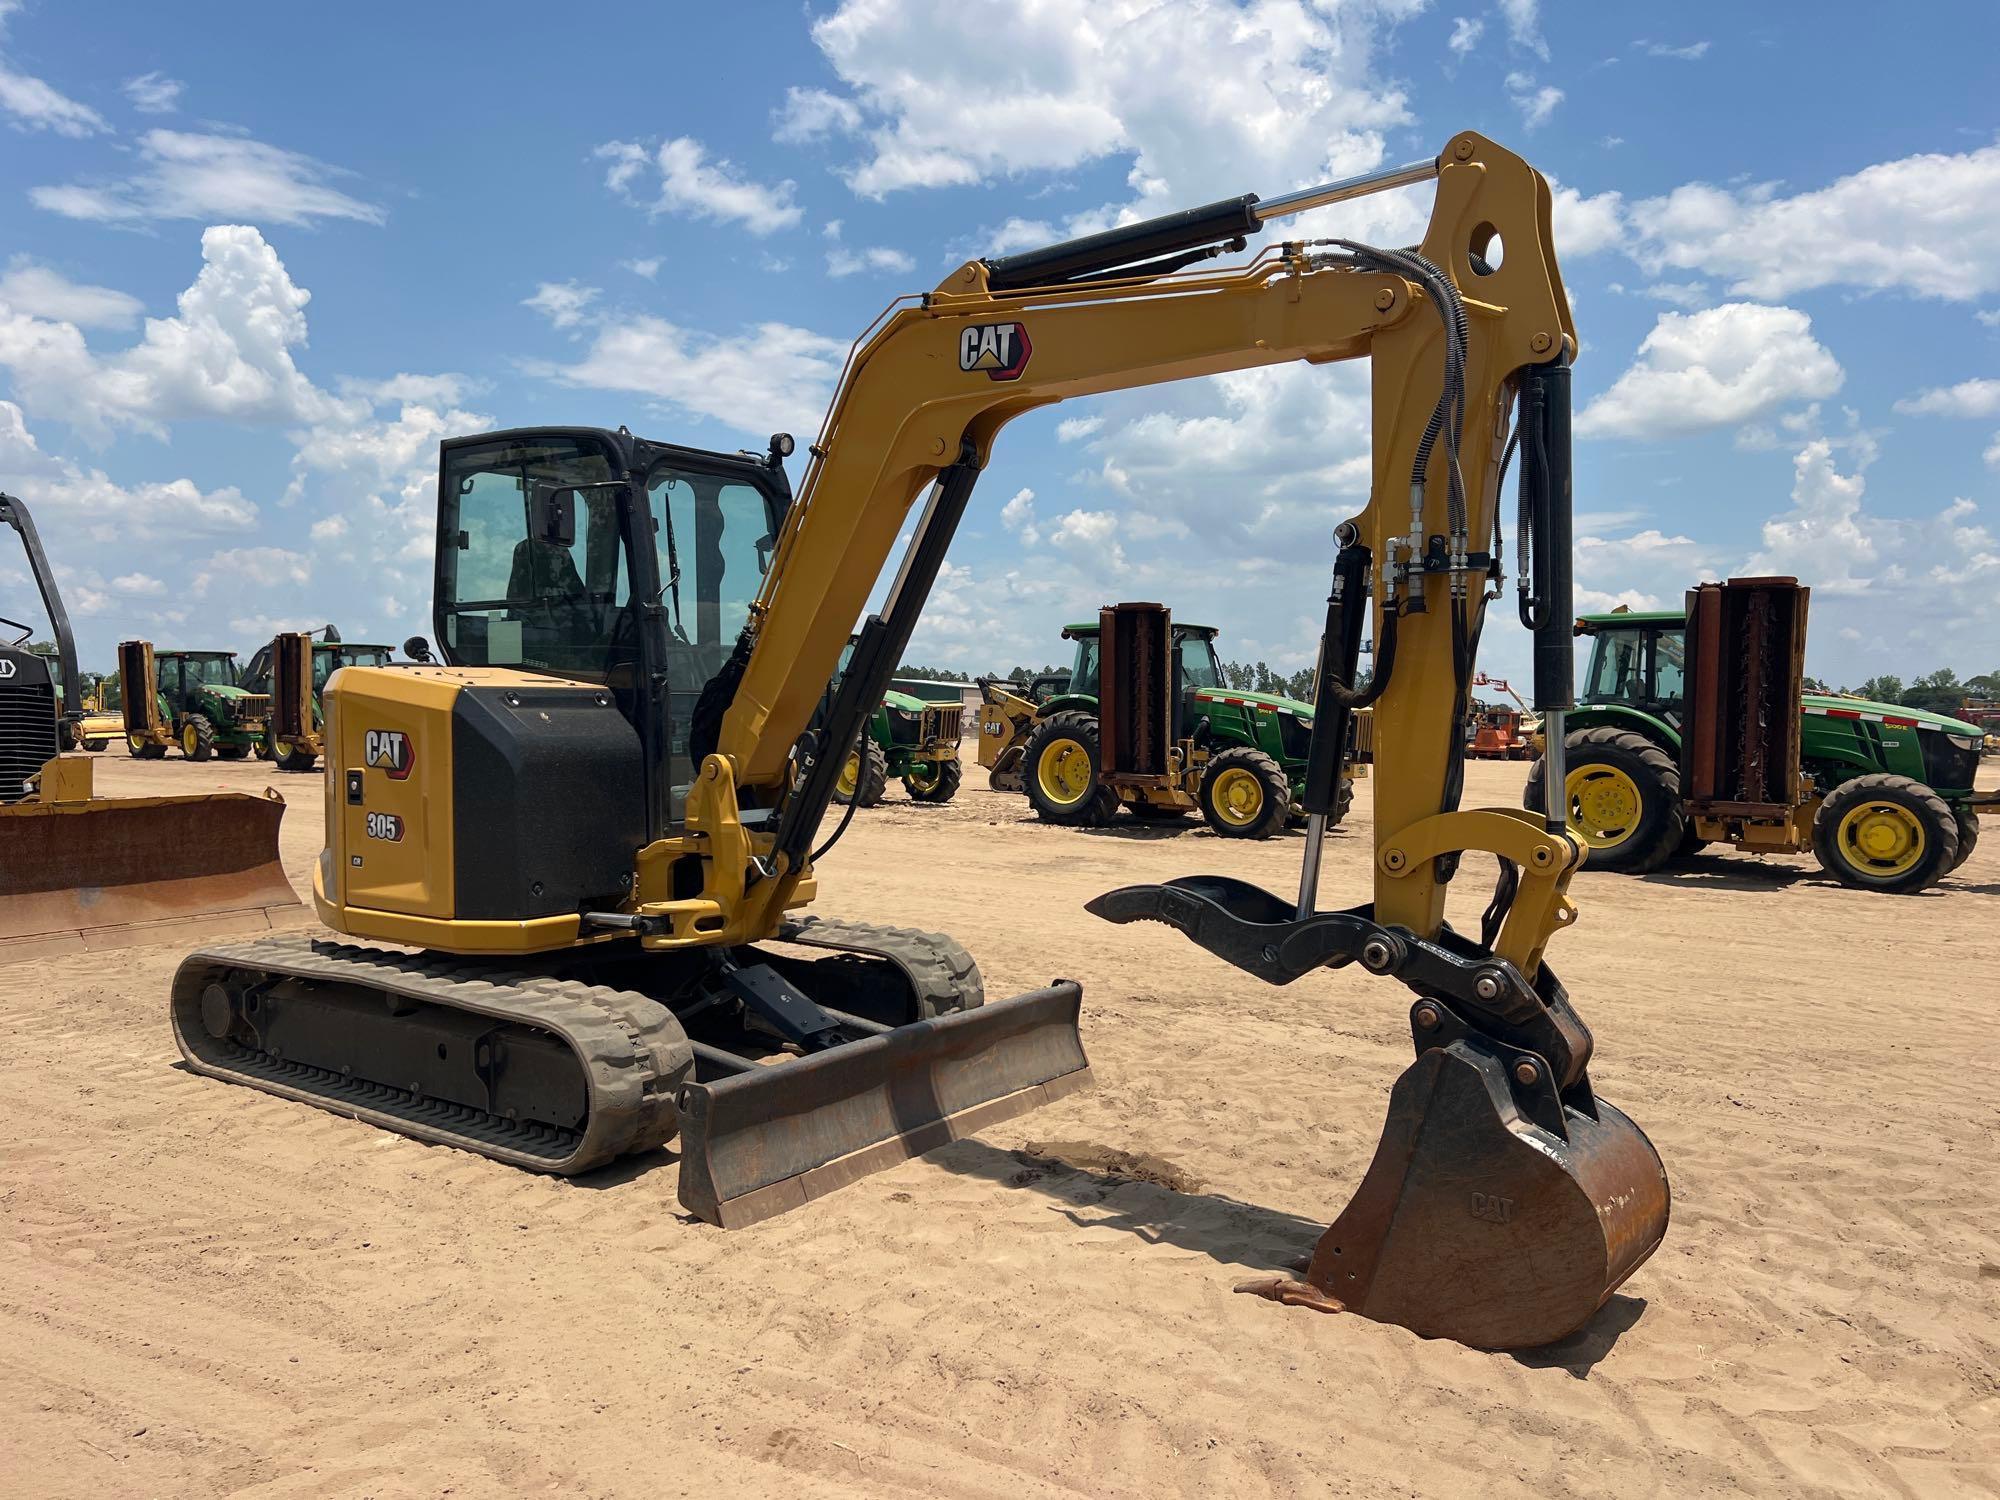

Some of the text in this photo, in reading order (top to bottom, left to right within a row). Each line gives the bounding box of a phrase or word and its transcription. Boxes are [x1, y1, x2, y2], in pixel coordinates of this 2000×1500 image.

[961, 324, 1015, 370] CAT
[984, 722, 1001, 735] CAT
[366, 730, 403, 769] CAT
[367, 813, 396, 840] 305
[1471, 1191, 1514, 1224] CAT
